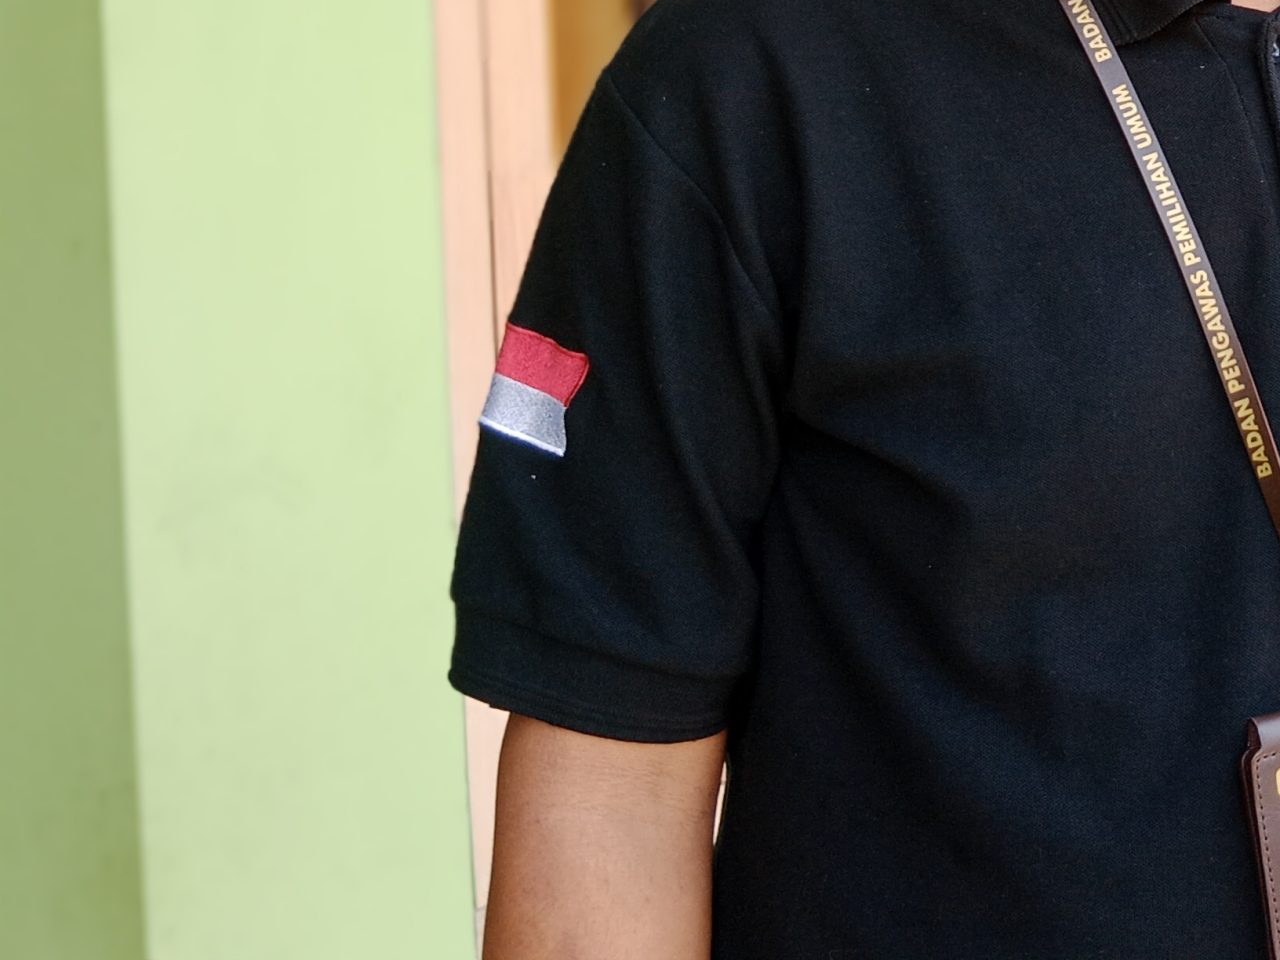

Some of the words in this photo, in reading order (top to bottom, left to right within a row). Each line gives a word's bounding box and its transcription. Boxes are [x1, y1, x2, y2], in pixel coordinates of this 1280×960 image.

[1111, 84, 1152, 149] UMUM
[1142, 151, 1201, 266] PEMILIHAN
[1189, 269, 1245, 394] PENGAWAS
[1234, 397, 1273, 479] BADAN
